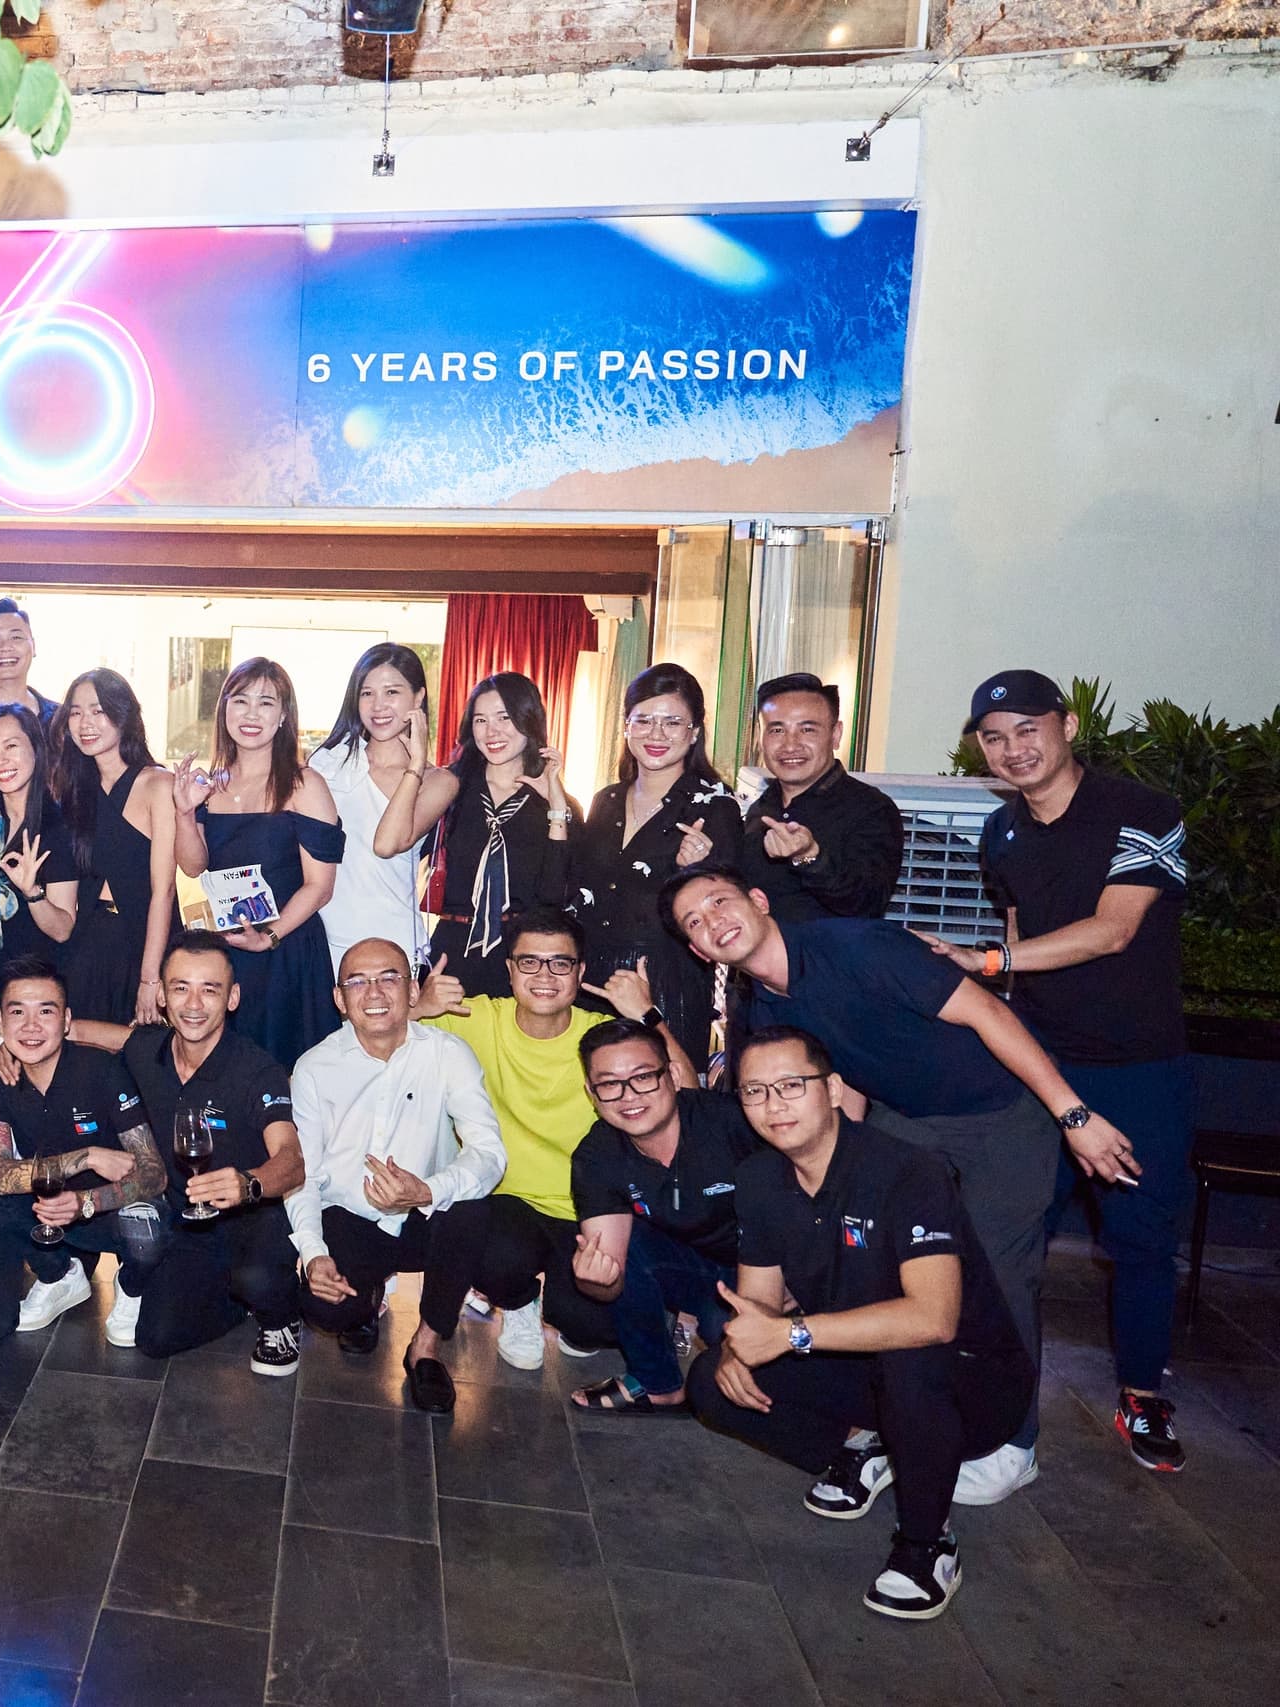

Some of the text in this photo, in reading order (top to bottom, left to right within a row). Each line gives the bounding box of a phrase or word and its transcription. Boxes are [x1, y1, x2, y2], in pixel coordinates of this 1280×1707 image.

[307, 349, 807, 383] 6 YEARS OF PASSION
